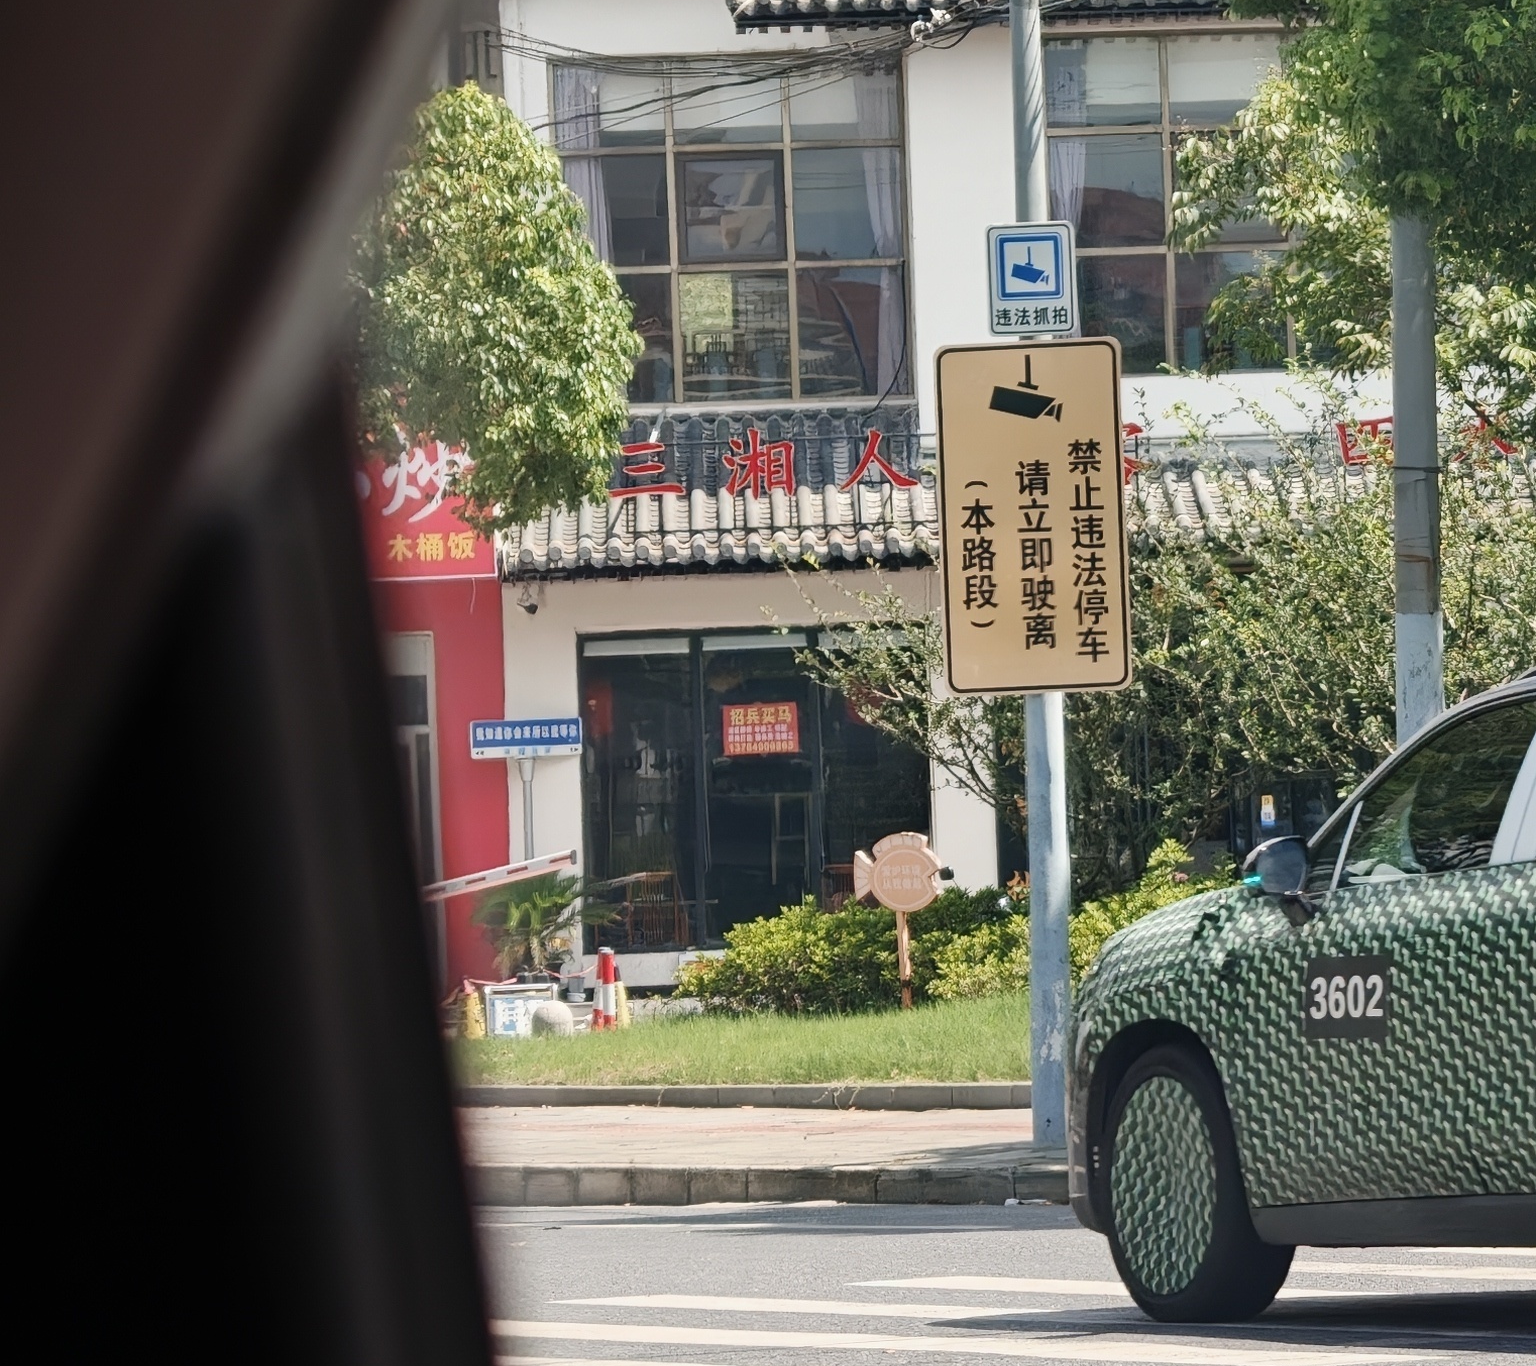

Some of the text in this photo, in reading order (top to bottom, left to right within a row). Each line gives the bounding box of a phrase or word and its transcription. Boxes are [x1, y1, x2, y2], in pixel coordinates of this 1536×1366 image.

[994, 305, 1069, 328] 违法抓拍
[387, 531, 477, 562] 木桶饭
[1016, 459, 1057, 651] 请立即驶离
[1067, 438, 1110, 664] 禁止违法停车
[729, 705, 792, 726] 招兵买马
[1309, 974, 1384, 1020] 3602
